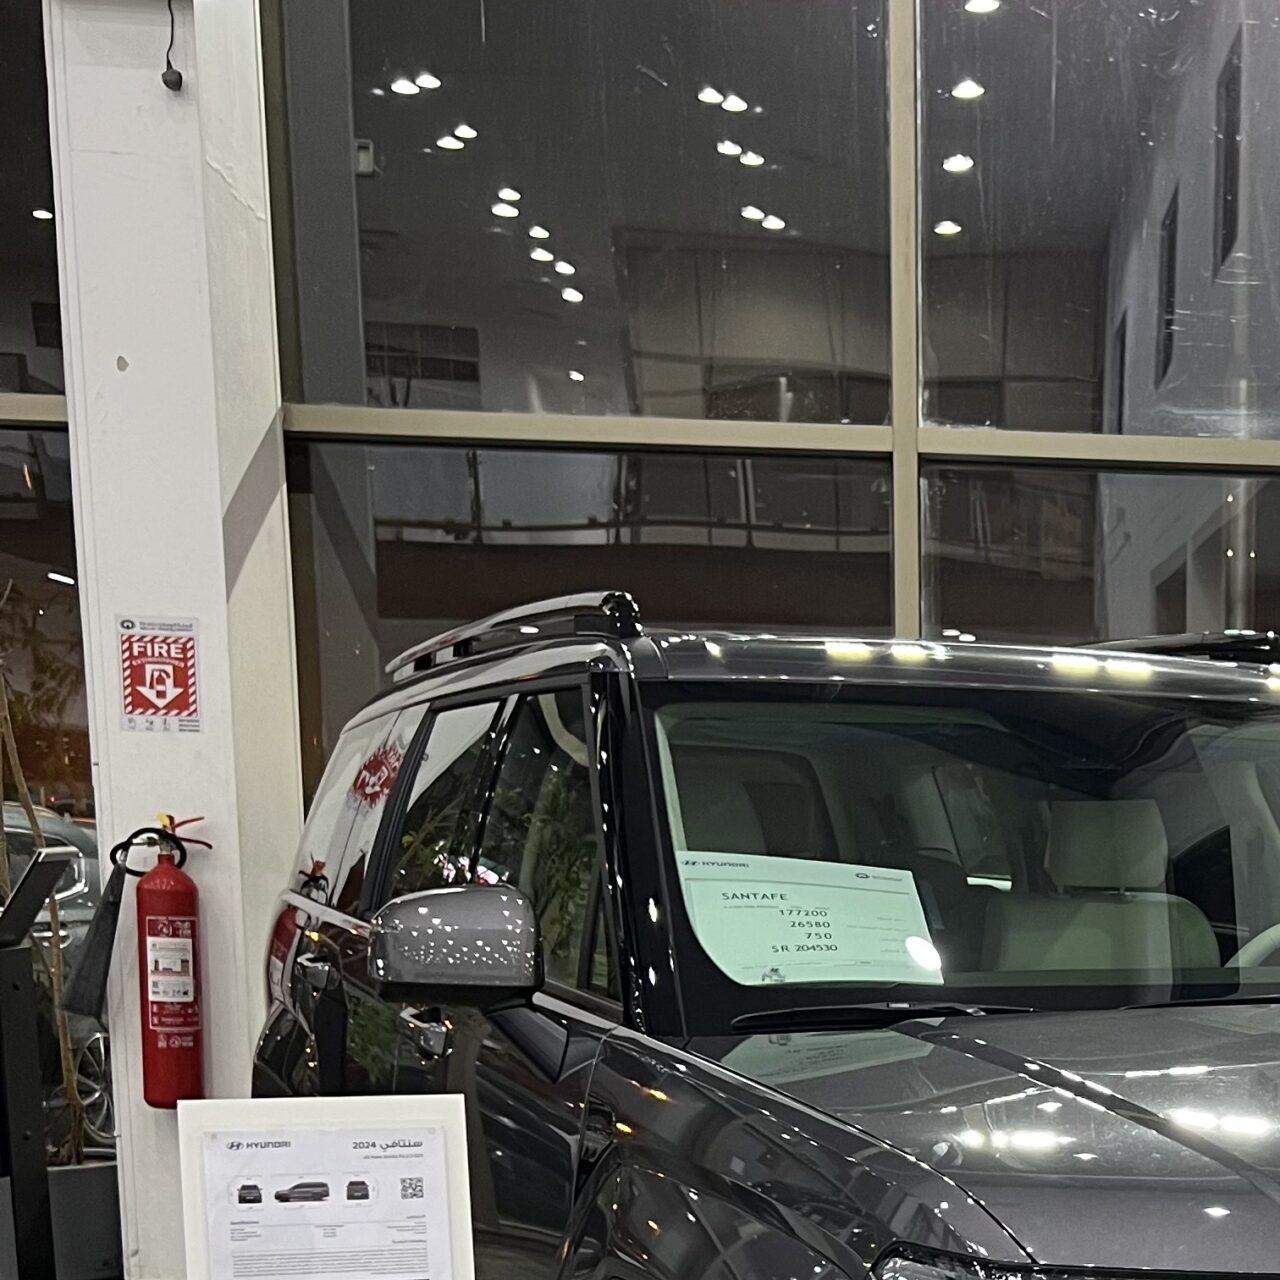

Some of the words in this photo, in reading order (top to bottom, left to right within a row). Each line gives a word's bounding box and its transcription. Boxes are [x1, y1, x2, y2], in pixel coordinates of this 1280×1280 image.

[132, 642, 184, 658] FIRE
[779, 909, 828, 917] 177200
[804, 932, 832, 940] 750
[771, 945, 790, 953] SR
[795, 944, 838, 952] 204530
[246, 1141, 291, 1149] HYUNDAI
[352, 1141, 377, 1149] 2024
